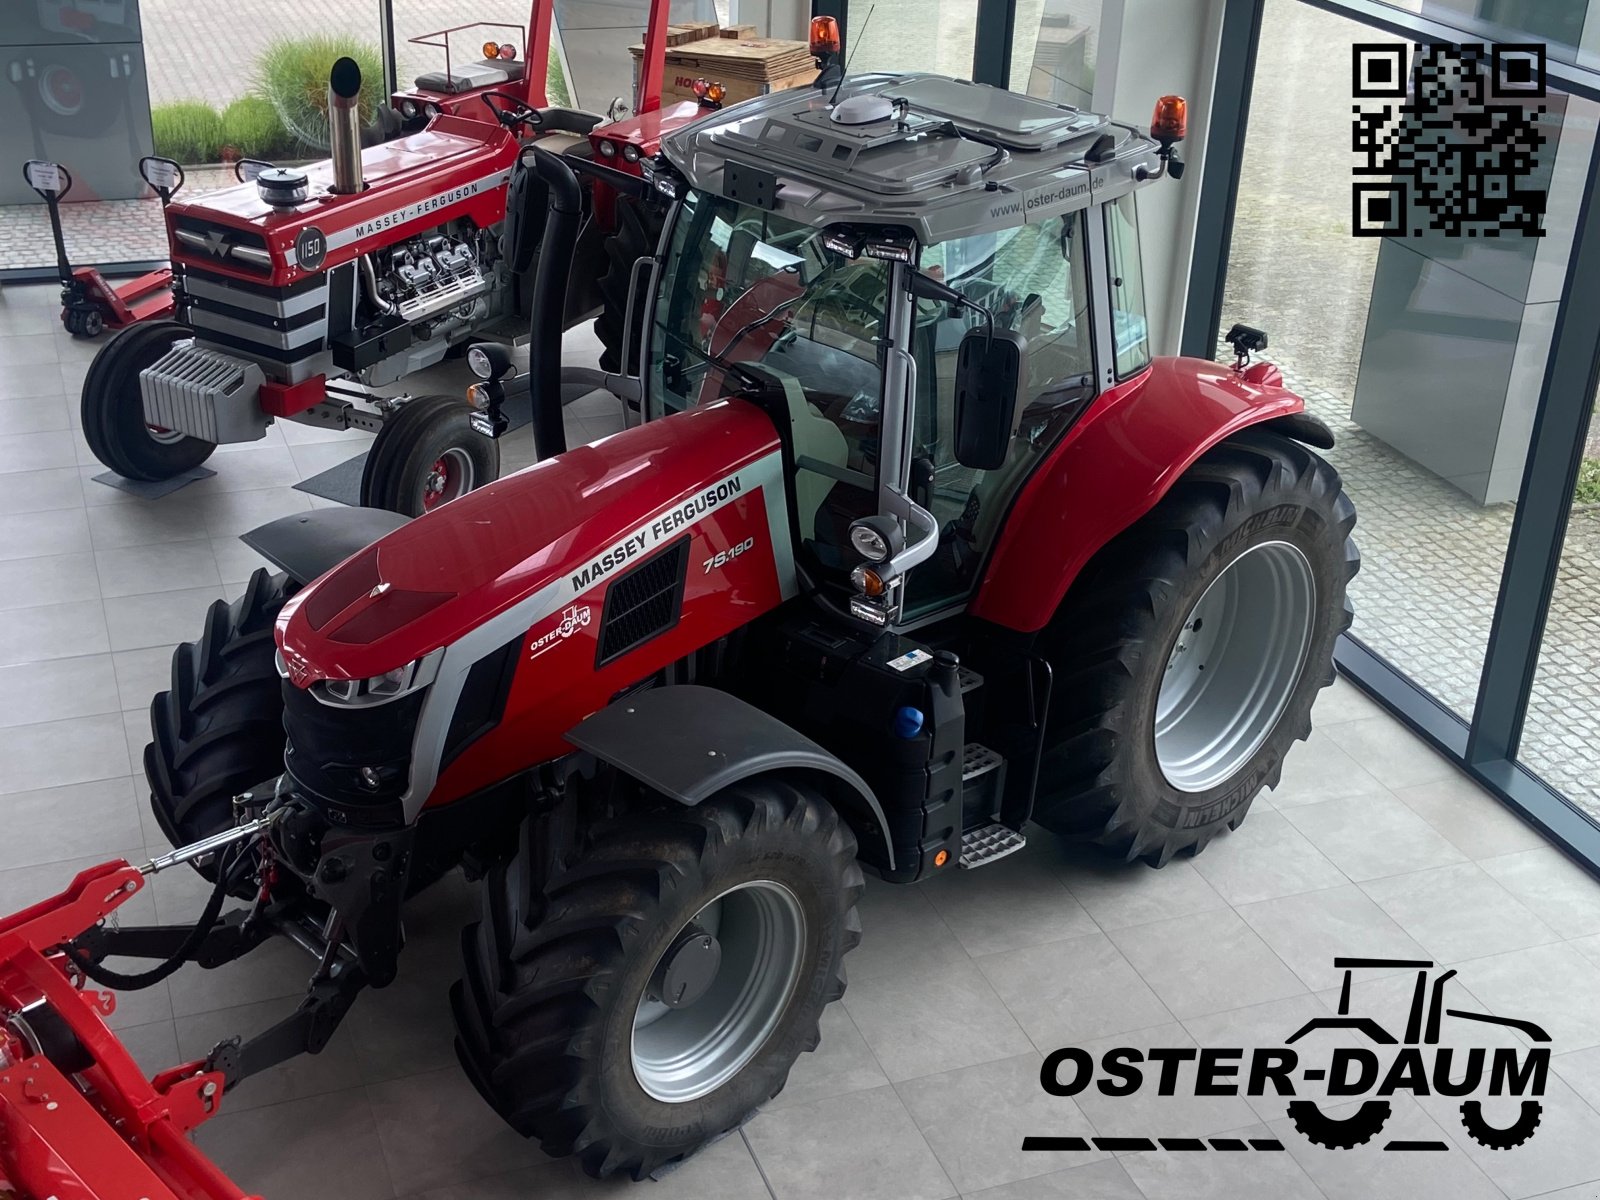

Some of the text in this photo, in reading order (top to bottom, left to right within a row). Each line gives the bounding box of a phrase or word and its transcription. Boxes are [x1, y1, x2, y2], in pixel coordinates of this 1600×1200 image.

[301, 238, 320, 259] 1150
[571, 476, 742, 592] MASSEY FERGUSON
[702, 536, 754, 574] 7S.190
[530, 608, 591, 651] OSTER-DAUM
